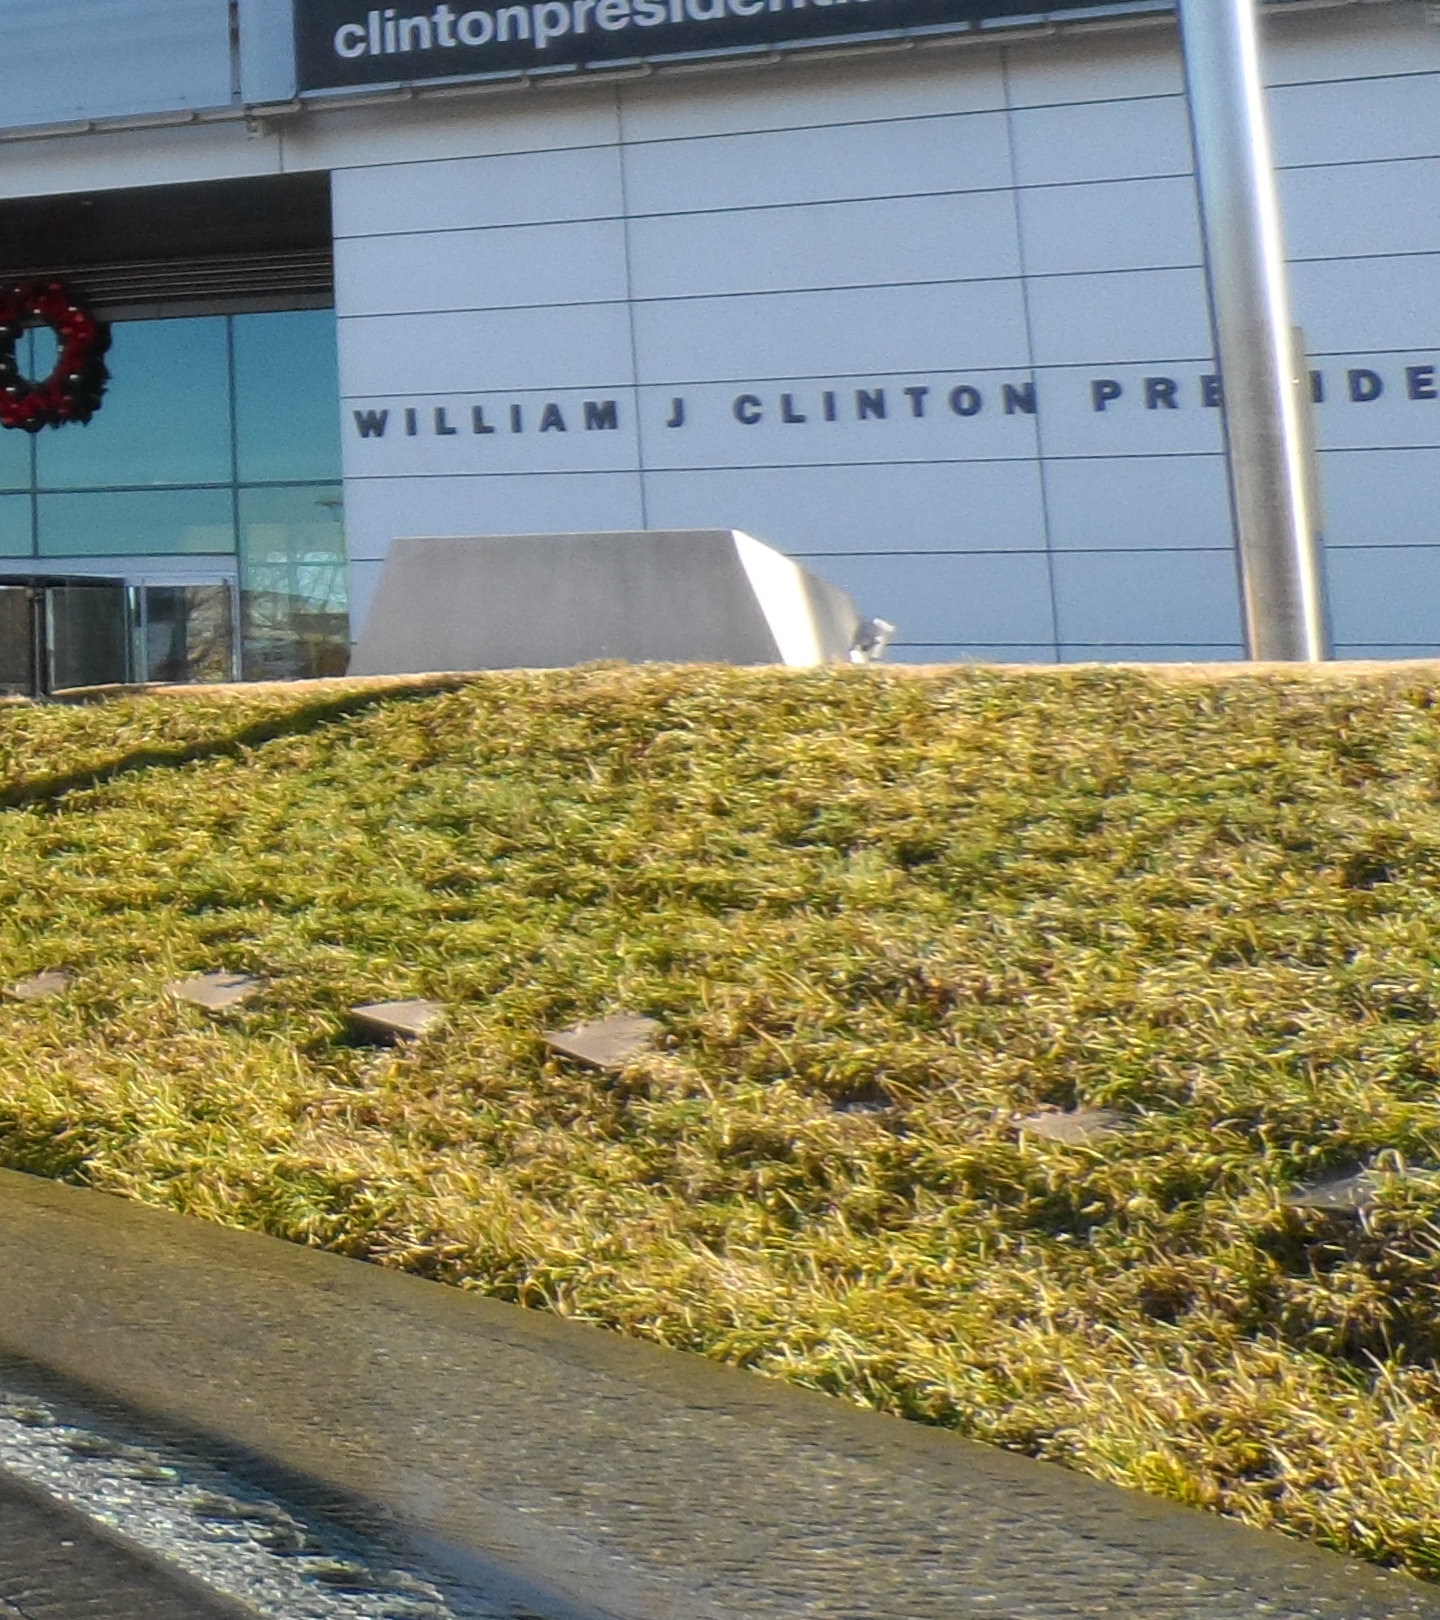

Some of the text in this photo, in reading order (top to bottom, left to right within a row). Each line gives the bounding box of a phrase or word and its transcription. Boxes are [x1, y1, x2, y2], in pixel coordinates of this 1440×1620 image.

[353, 365, 1437, 439] WILLIAM J CLINTON PREIDE
